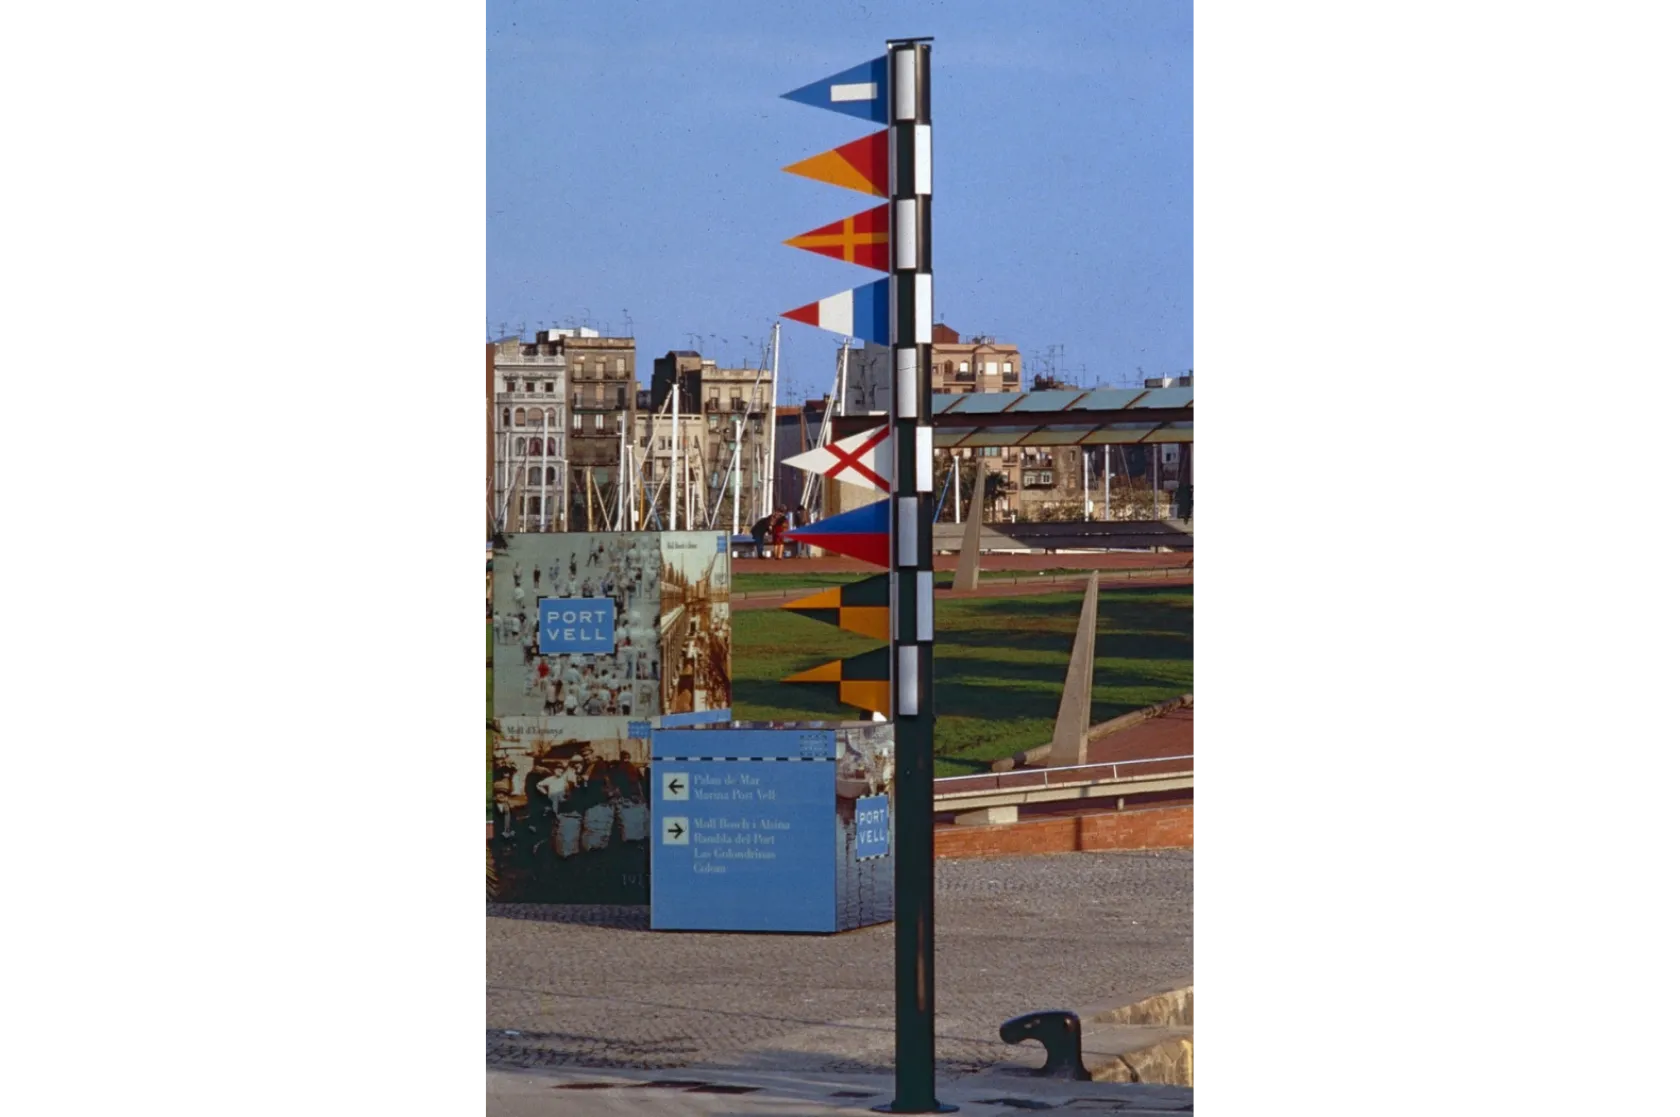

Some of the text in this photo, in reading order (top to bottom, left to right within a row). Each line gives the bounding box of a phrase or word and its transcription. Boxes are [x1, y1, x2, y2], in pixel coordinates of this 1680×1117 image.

[547, 611, 607, 624] PORT
[547, 628, 607, 641] VELL
[694, 774, 760, 785] Palau de Mar
[694, 788, 777, 800] Marina Port Vell
[694, 817, 716, 829] Moll
[859, 809, 885, 825] PORT
[694, 832, 775, 844] Rambla del Port
[859, 829, 885, 844] VELL
